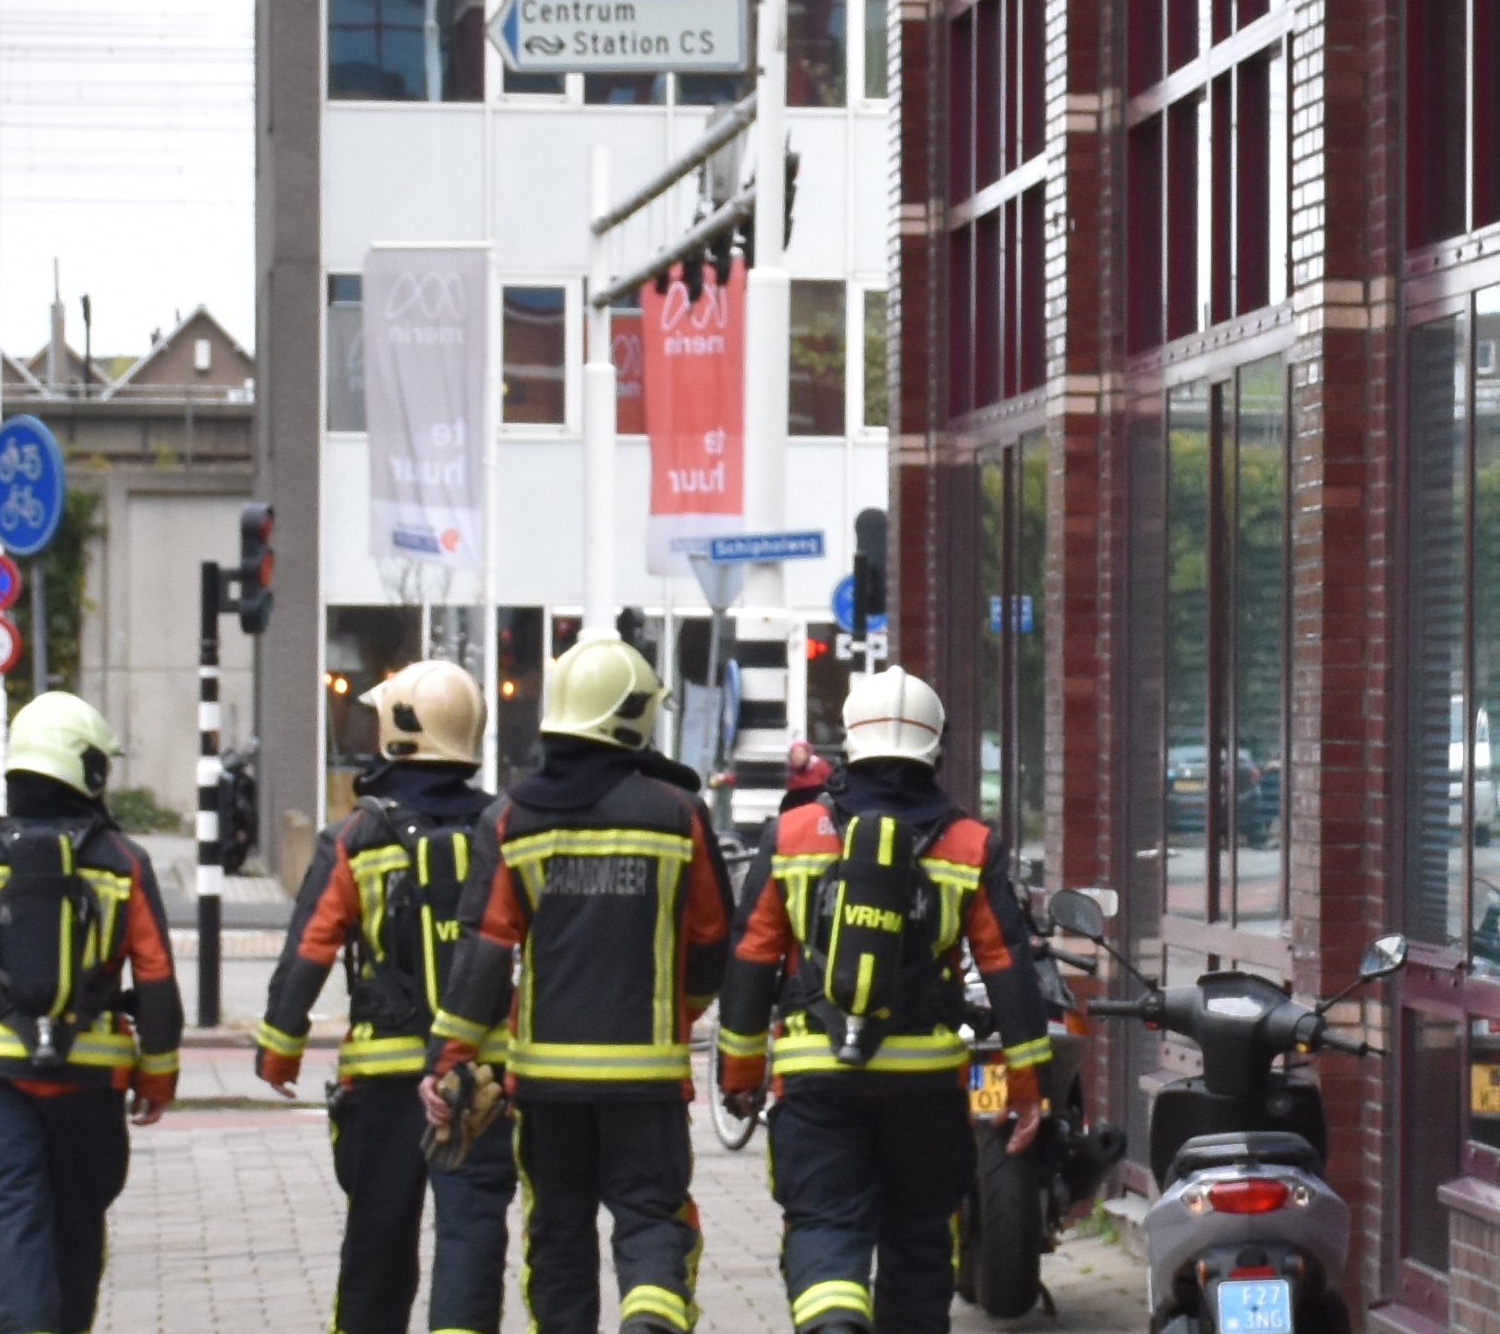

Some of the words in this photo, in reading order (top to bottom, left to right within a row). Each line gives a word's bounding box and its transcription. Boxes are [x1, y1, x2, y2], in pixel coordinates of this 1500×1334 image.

[572, 30, 670, 56] Station
[679, 29, 715, 55] CS
[542, 855, 647, 896] BRANDWEER
[1242, 1285, 1280, 1305] F27
